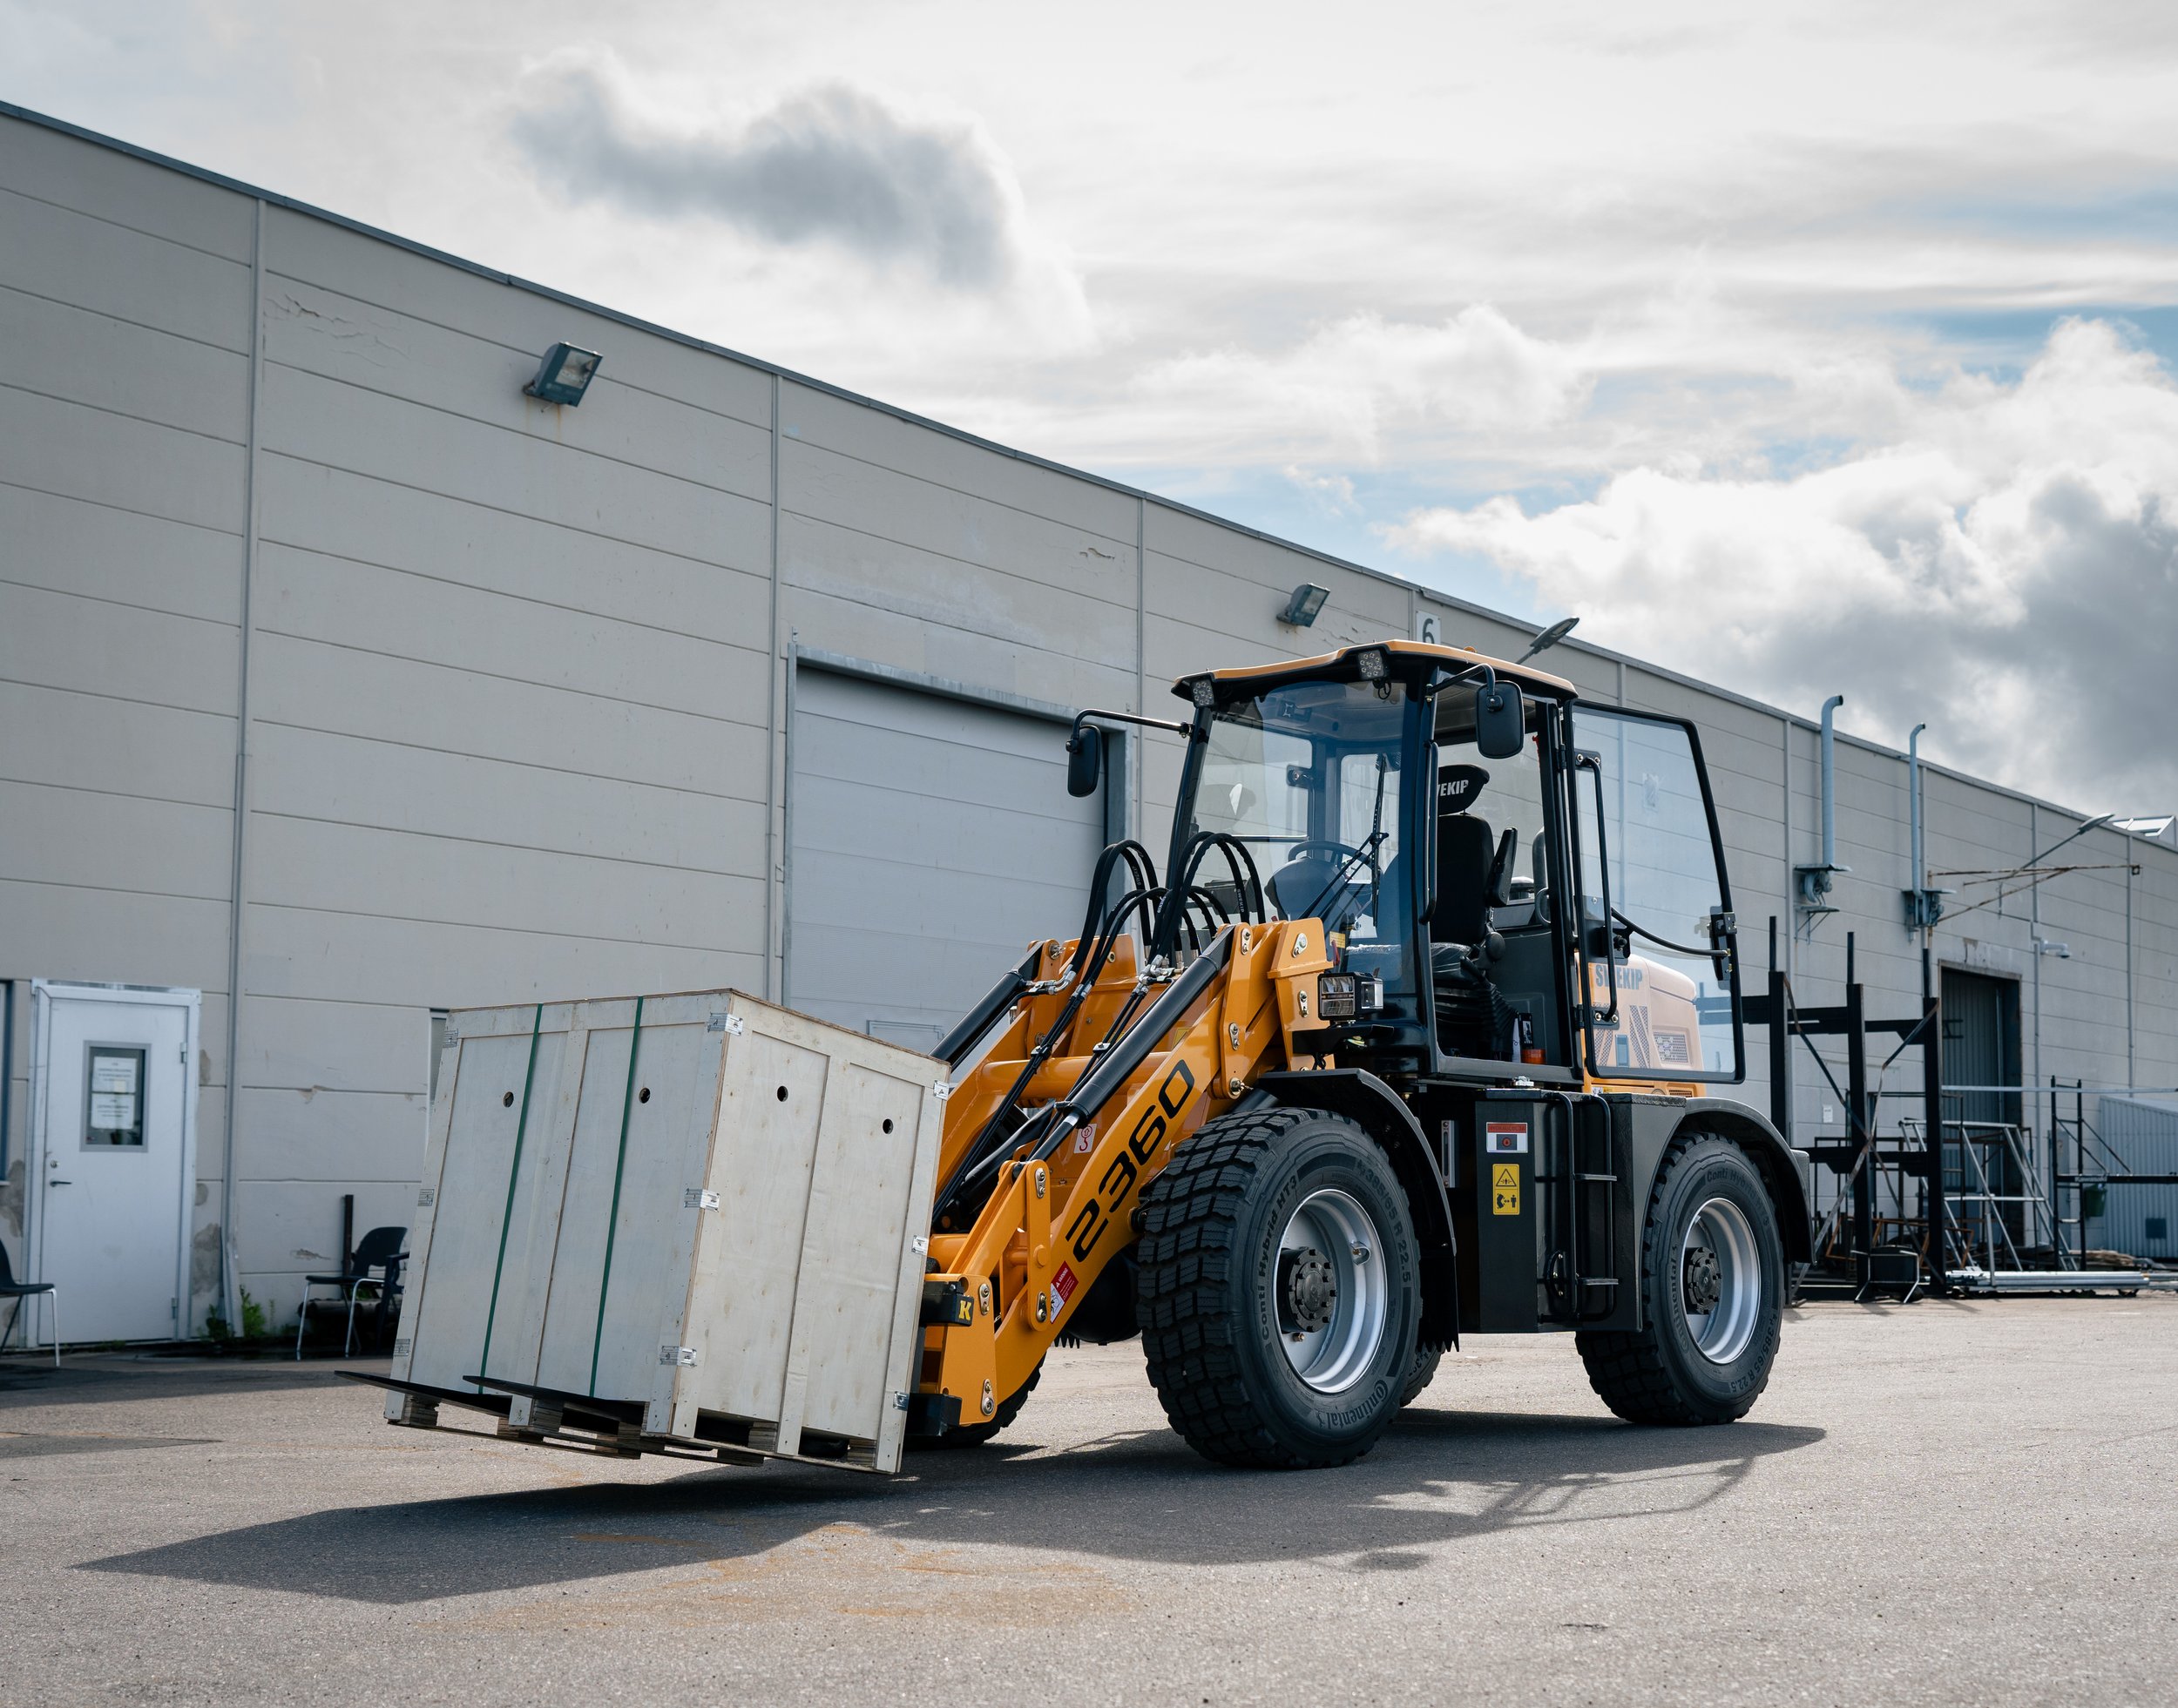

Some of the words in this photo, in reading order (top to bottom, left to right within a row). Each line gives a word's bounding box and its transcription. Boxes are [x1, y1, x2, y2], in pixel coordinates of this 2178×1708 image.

[1423, 618, 1435, 644] 6
[1437, 780, 1469, 797] EKIP
[1065, 1059, 1195, 1263] 2360
[1707, 1167, 1728, 1182] Conti
[1276, 1174, 1297, 1210] HT3
[1258, 1210, 1278, 1279] Hybrid
[1393, 1223, 1404, 1237] R
[1397, 1239, 1412, 1283] 22.5
[958, 1300, 972, 1320] K
[1258, 1286, 1270, 1340] Conti
[1754, 1327, 1775, 1374] 385/65
[1730, 1376, 1749, 1393] 22.5
[1748, 1369, 1755, 1381] R
[1326, 1379, 1389, 1429] Continental
